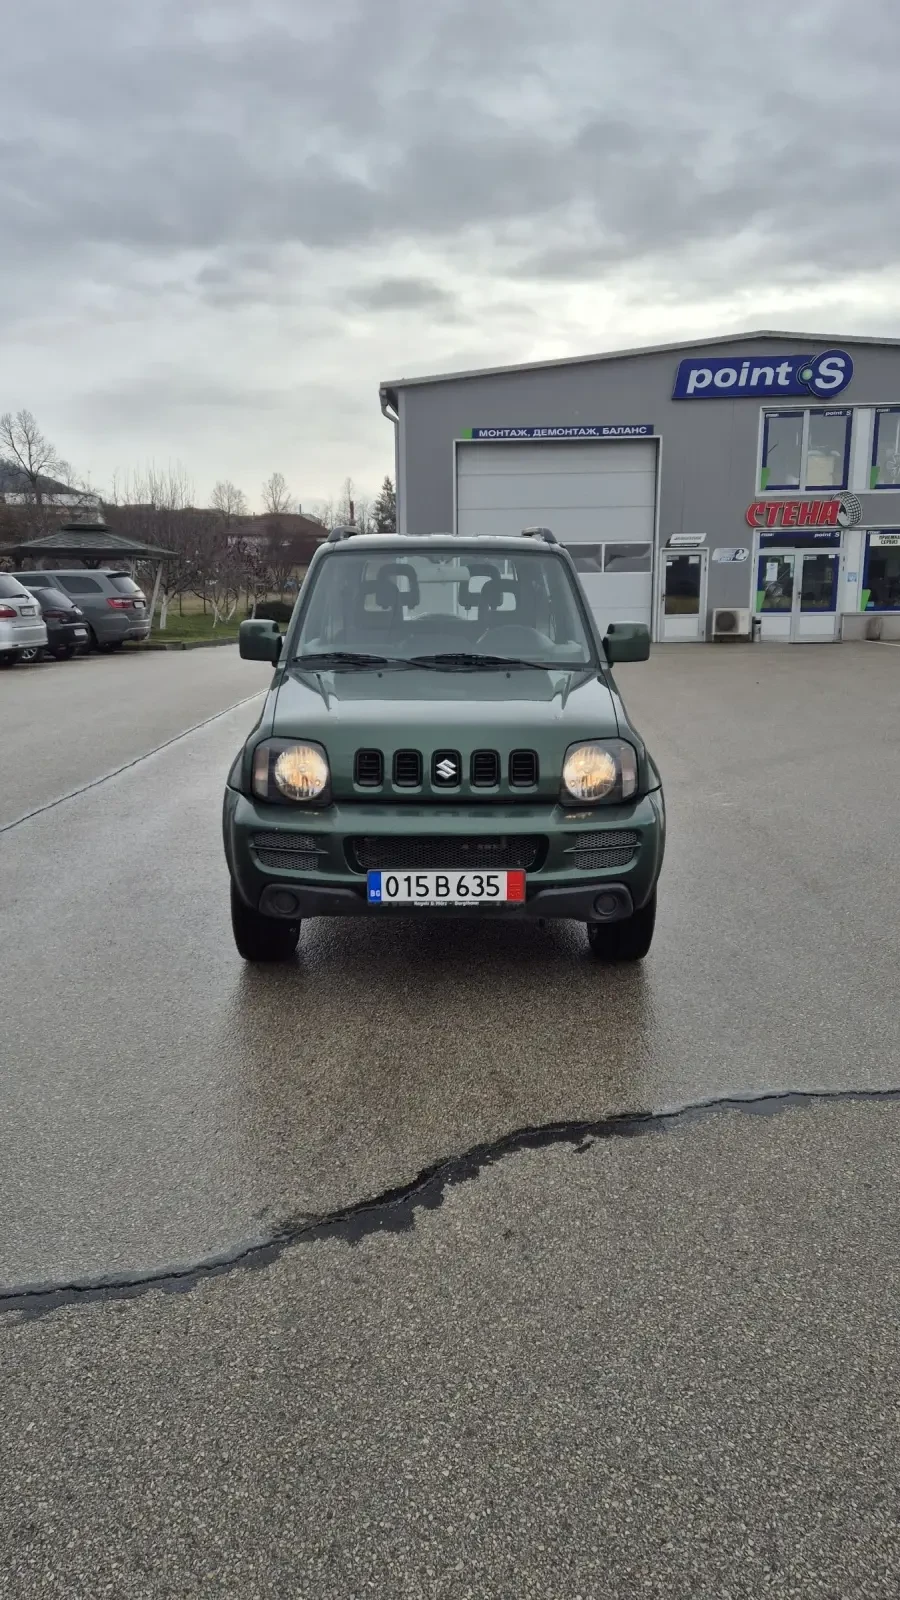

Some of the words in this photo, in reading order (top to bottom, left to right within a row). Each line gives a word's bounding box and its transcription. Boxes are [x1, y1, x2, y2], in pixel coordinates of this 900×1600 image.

[686, 362, 792, 394] point
[815, 357, 846, 389] S
[479, 429, 531, 438] МОНТАЖ,
[533, 427, 600, 437] ДЕМОНТАЖ,
[603, 426, 647, 435] БАЛАНС
[746, 500, 841, 527] СТЕНА
[370, 889, 381, 897] BG
[385, 875, 430, 898] 015
[435, 875, 451, 898] B
[456, 875, 500, 898] 635
